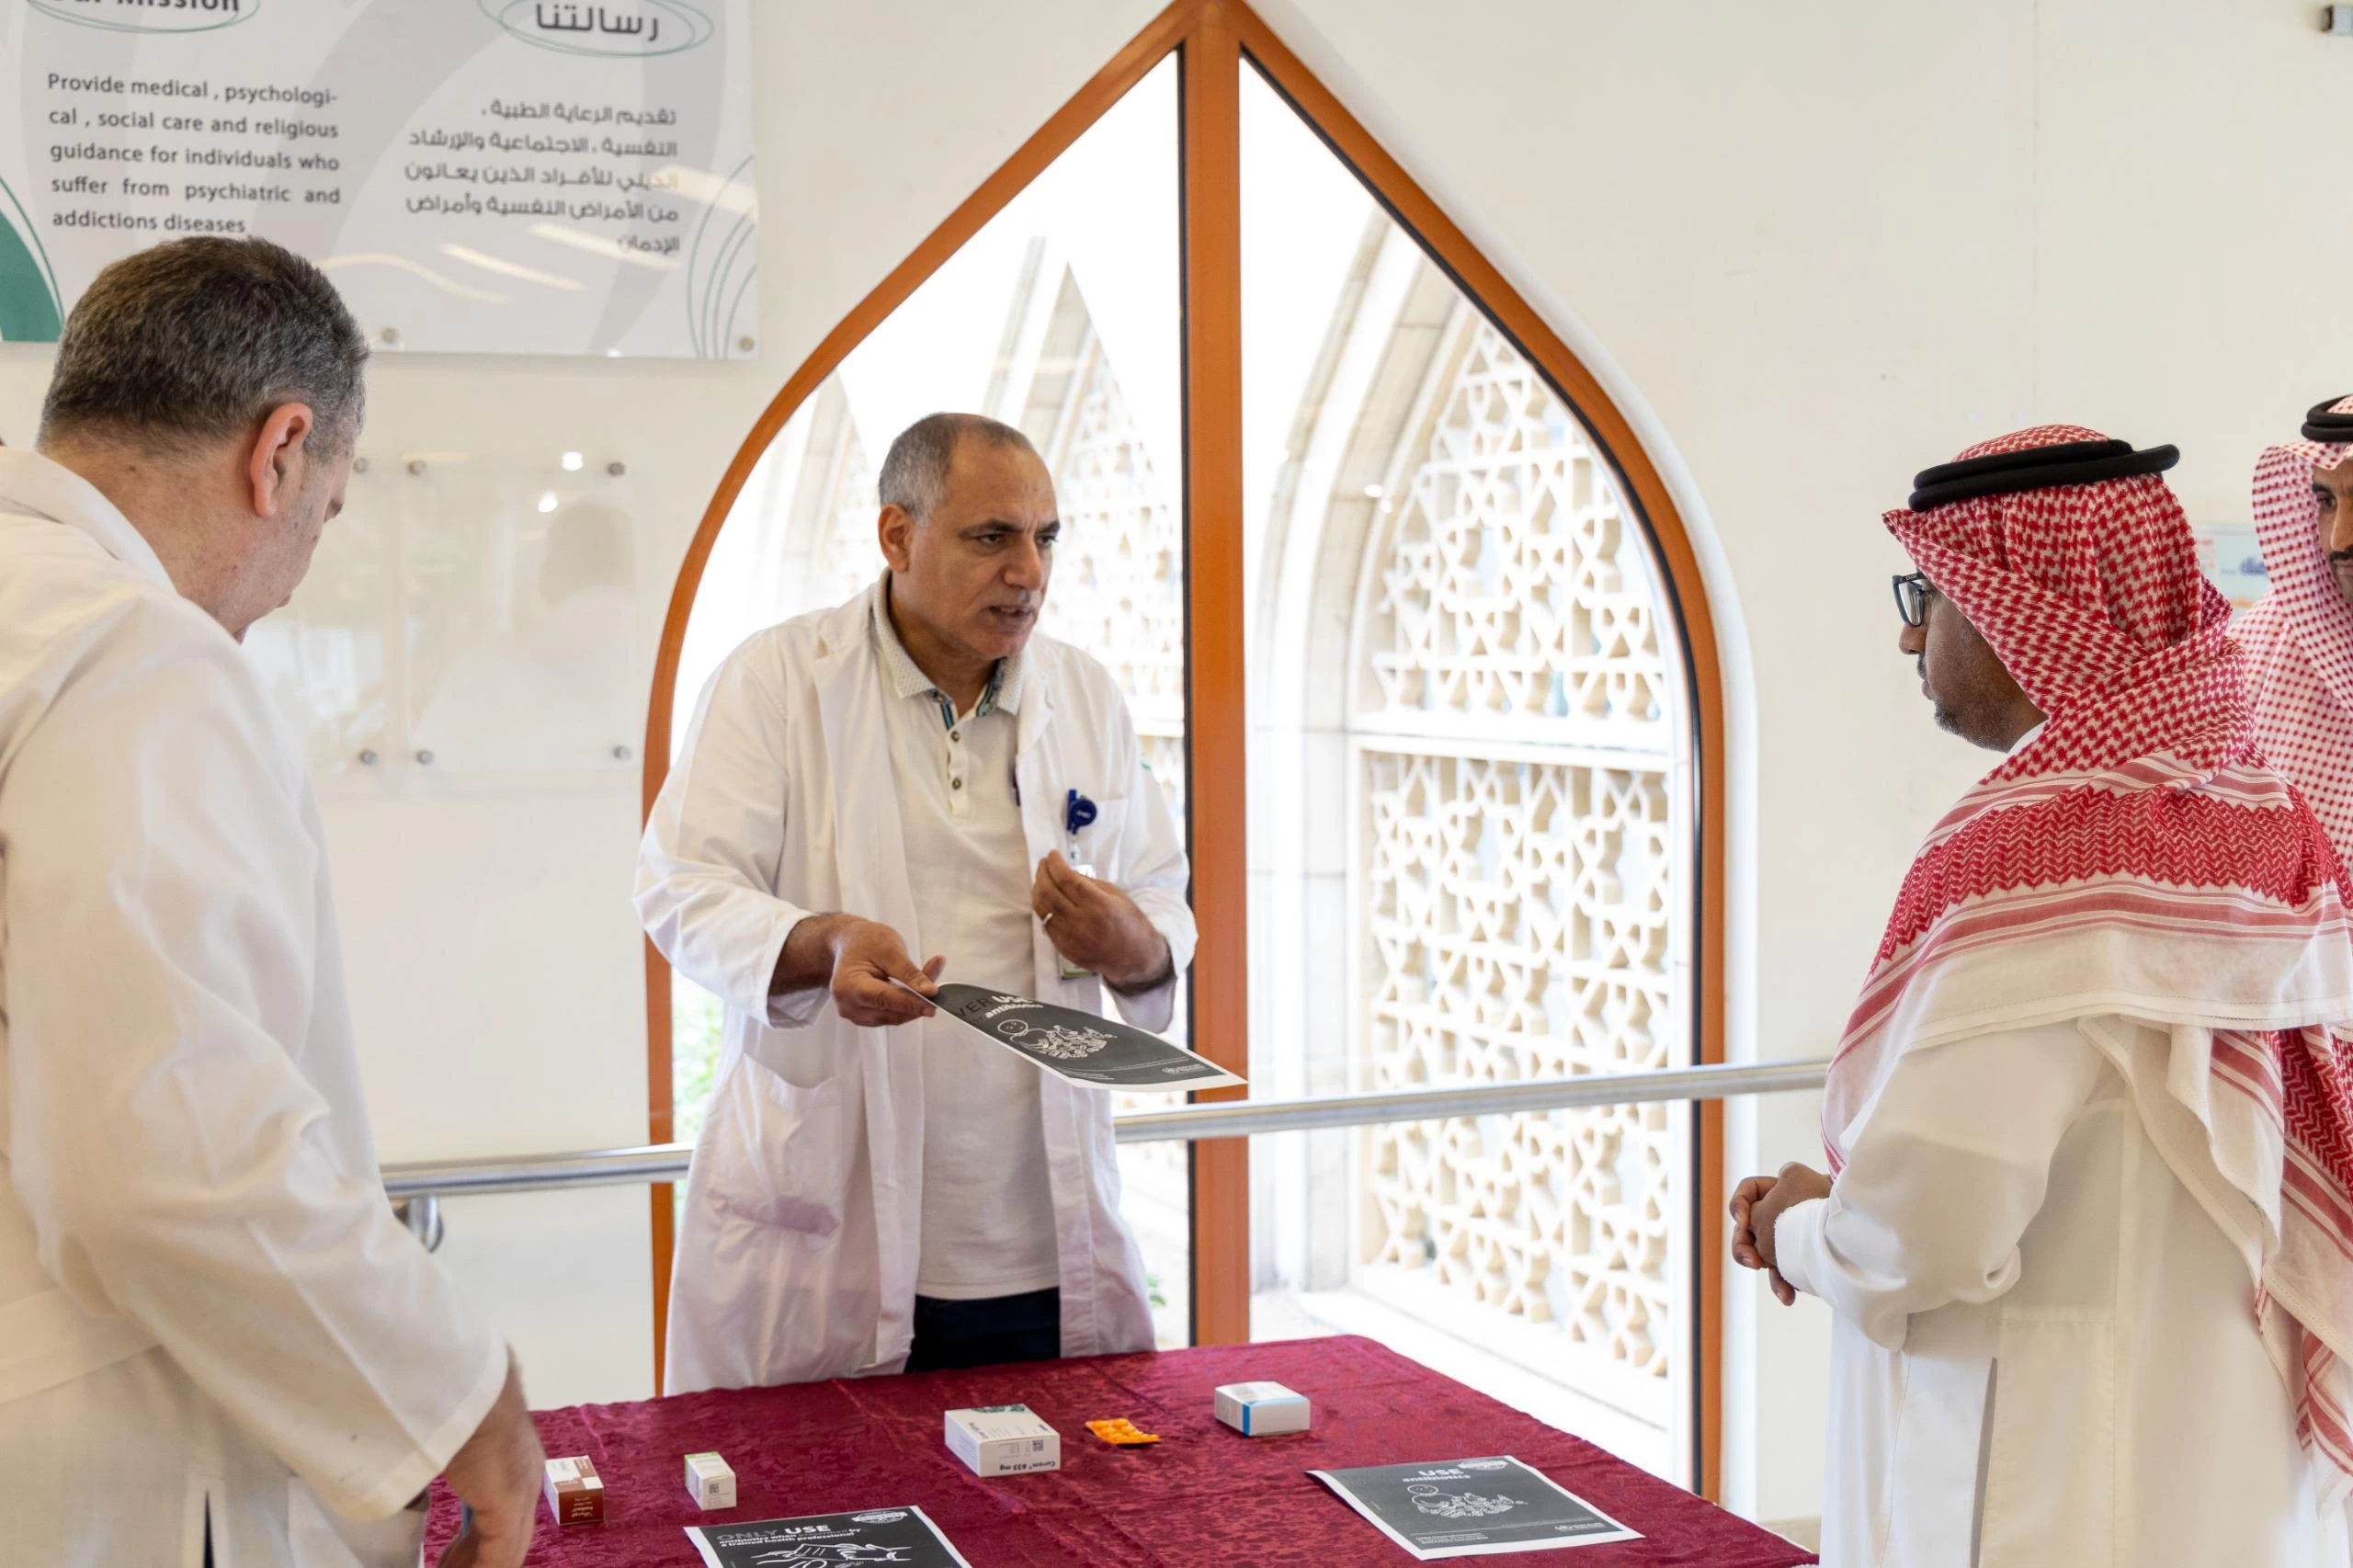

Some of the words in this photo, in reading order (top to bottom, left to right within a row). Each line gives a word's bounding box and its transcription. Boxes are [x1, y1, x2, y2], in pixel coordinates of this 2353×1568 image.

[118, 0, 239, 12] ssion
[536, 4, 658, 42] رسالتنا
[48, 74, 125, 94] Provide
[131, 79, 208, 97] medical
[225, 85, 336, 108] psychologi-
[490, 99, 550, 120] الطبية
[553, 102, 613, 125] الرعاية
[616, 108, 676, 127] تقديم
[49, 108, 77, 124] cal
[98, 111, 153, 129] social
[162, 117, 203, 131] care
[210, 117, 247, 133] and
[255, 119, 338, 140] religious
[489, 131, 588, 154] الاجتماعية
[601, 136, 676, 158] النفسية
[50, 142, 143, 162] guidance
[150, 145, 178, 164] for
[186, 148, 292, 169] individuals
[298, 153, 340, 171] who
[482, 166, 535, 185] الذين
[51, 176, 108, 194] suffer
[122, 177, 169, 196] from
[185, 183, 290, 202] psychiatric
[304, 187, 340, 204] and
[406, 191, 483, 215] وأمراض
[486, 196, 565, 217] النفسية
[569, 199, 643, 221] الأمراض
[52, 210, 158, 230] addictions
[164, 214, 245, 233] diseases
[647, 206, 679, 223] من
[953, 997, 995, 1017] VER
[717, 1528, 778, 1540] ONLY
[784, 1524, 832, 1534] USE
